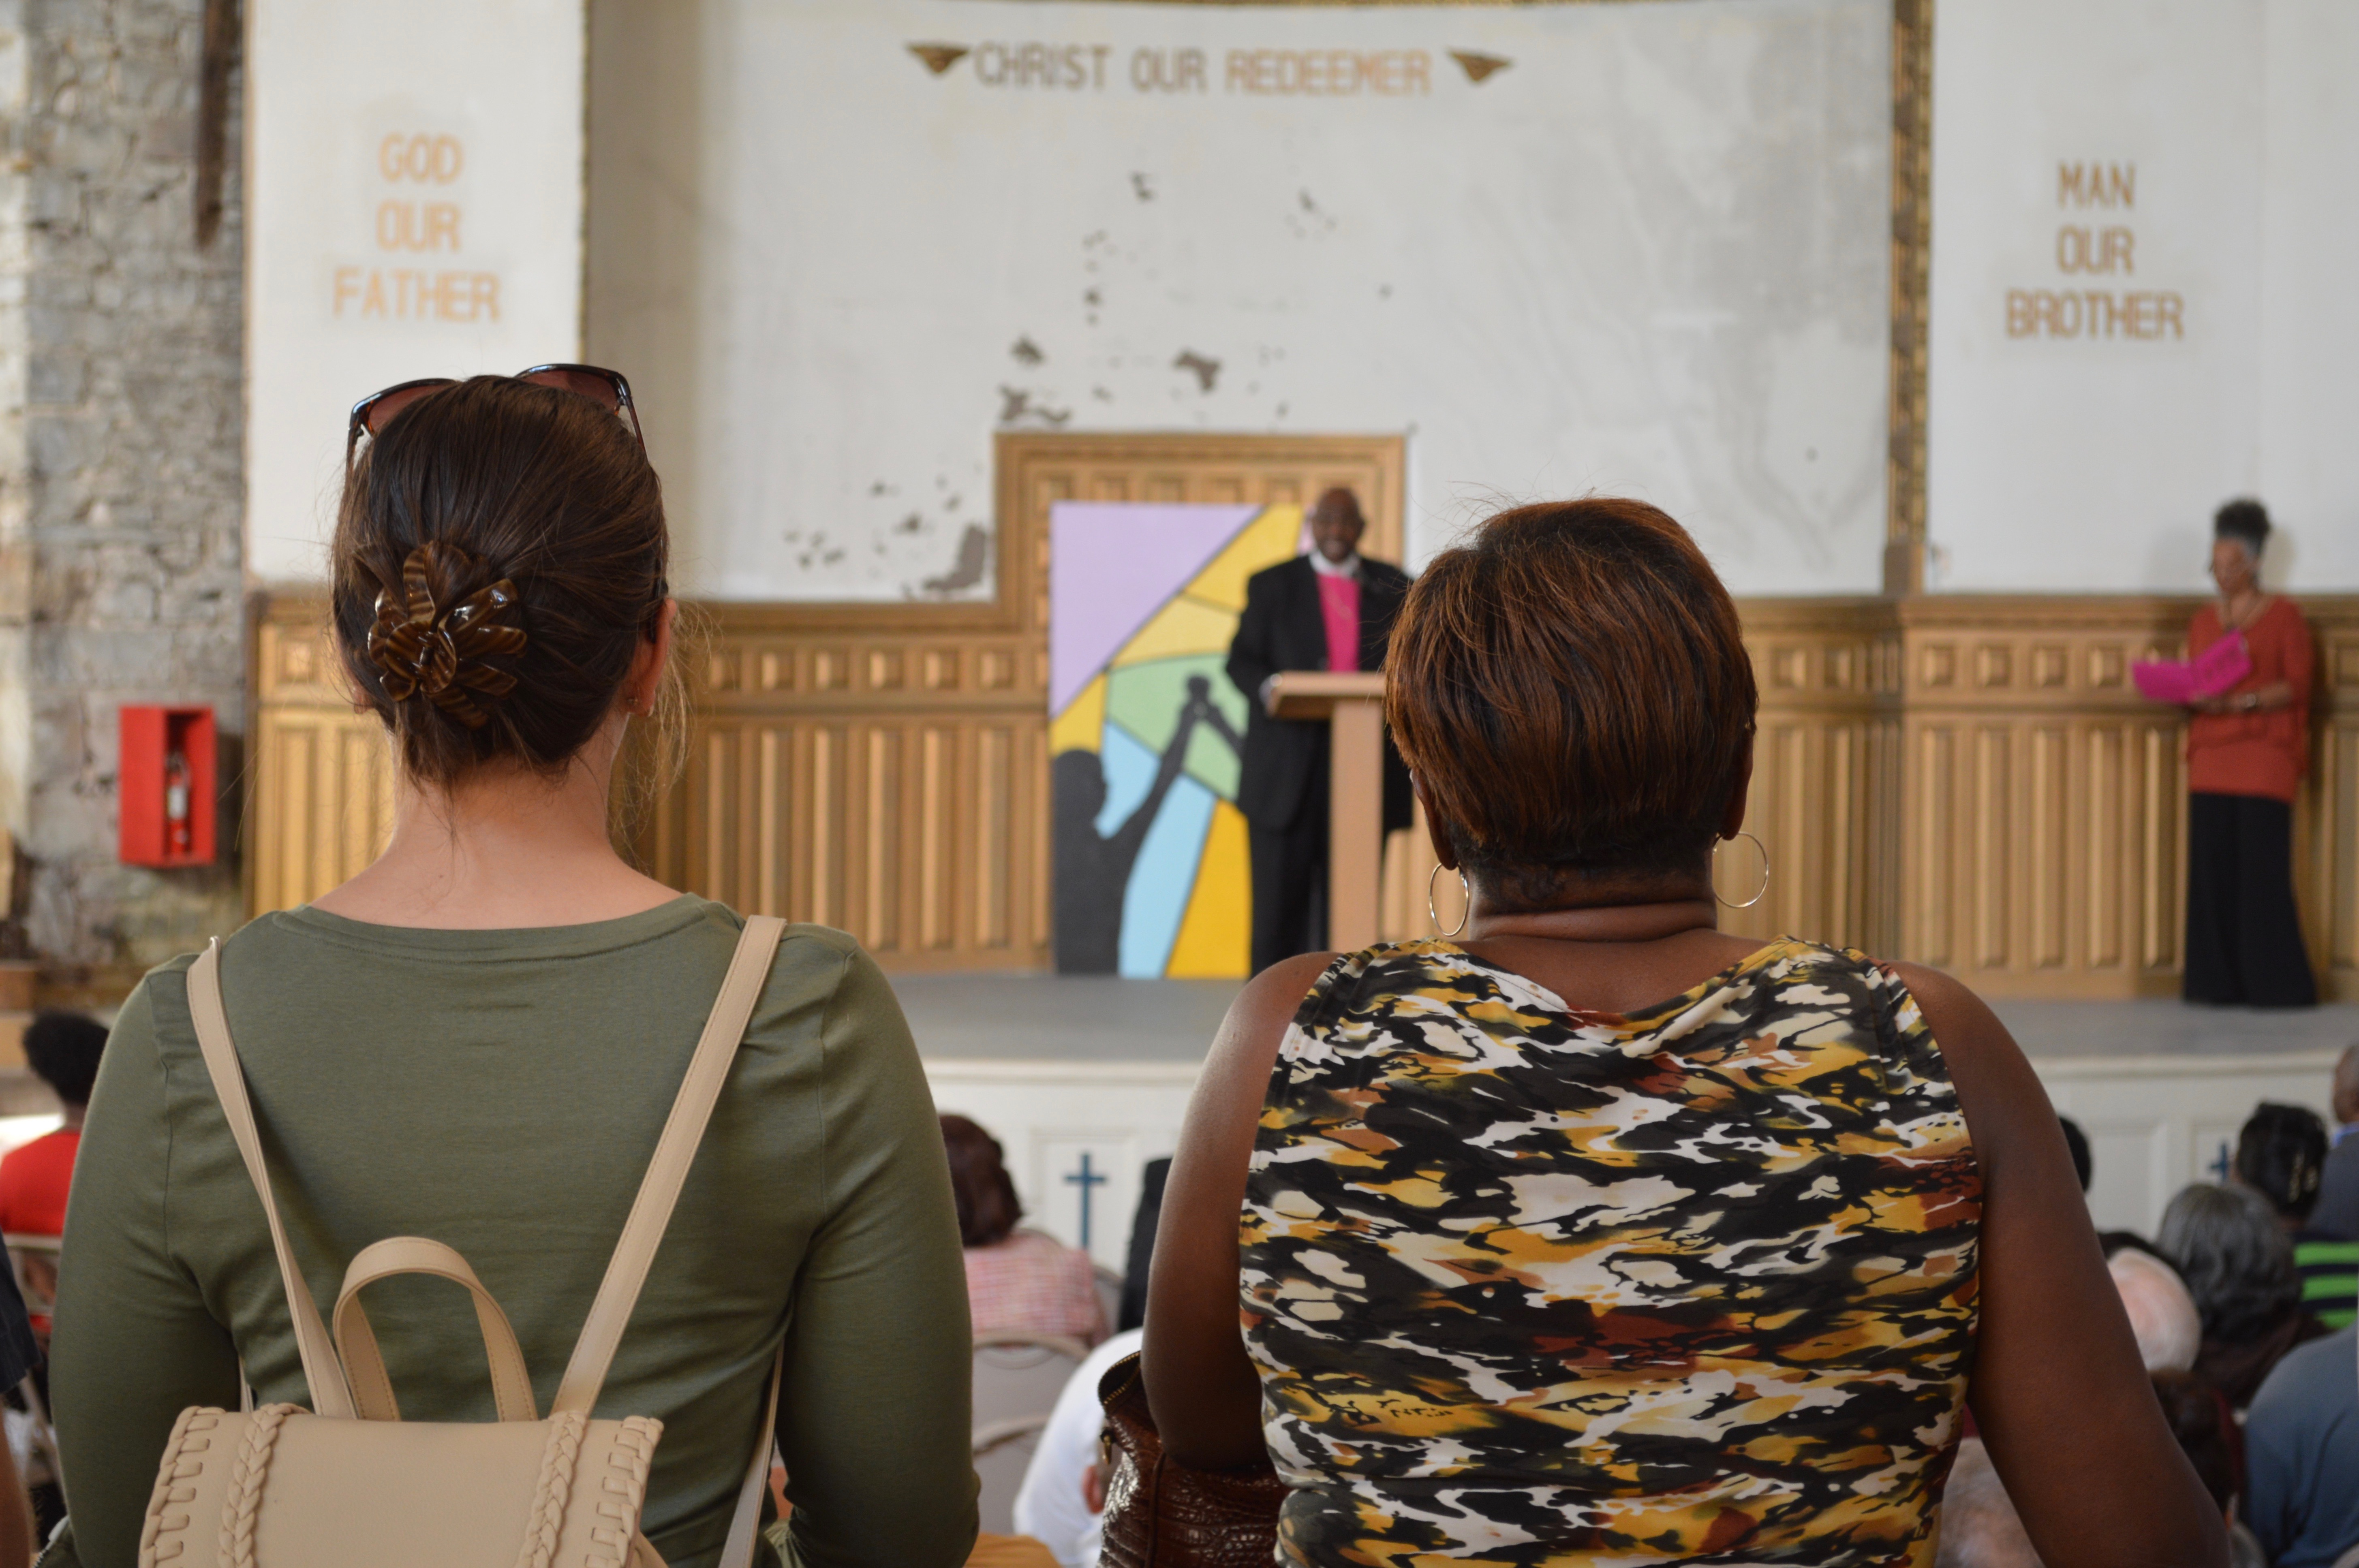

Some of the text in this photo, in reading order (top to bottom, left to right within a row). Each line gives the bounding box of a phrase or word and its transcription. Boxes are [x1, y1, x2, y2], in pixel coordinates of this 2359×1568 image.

[973, 43, 1433, 96] CHRIST OUR REDEEMER
[379, 132, 463, 183] GOD
[2058, 160, 2135, 208] MAN
[376, 200, 461, 252] OUR
[2056, 224, 2134, 275] OUR
[334, 266, 499, 322] FATHER
[2006, 288, 2184, 341] BROTHER
